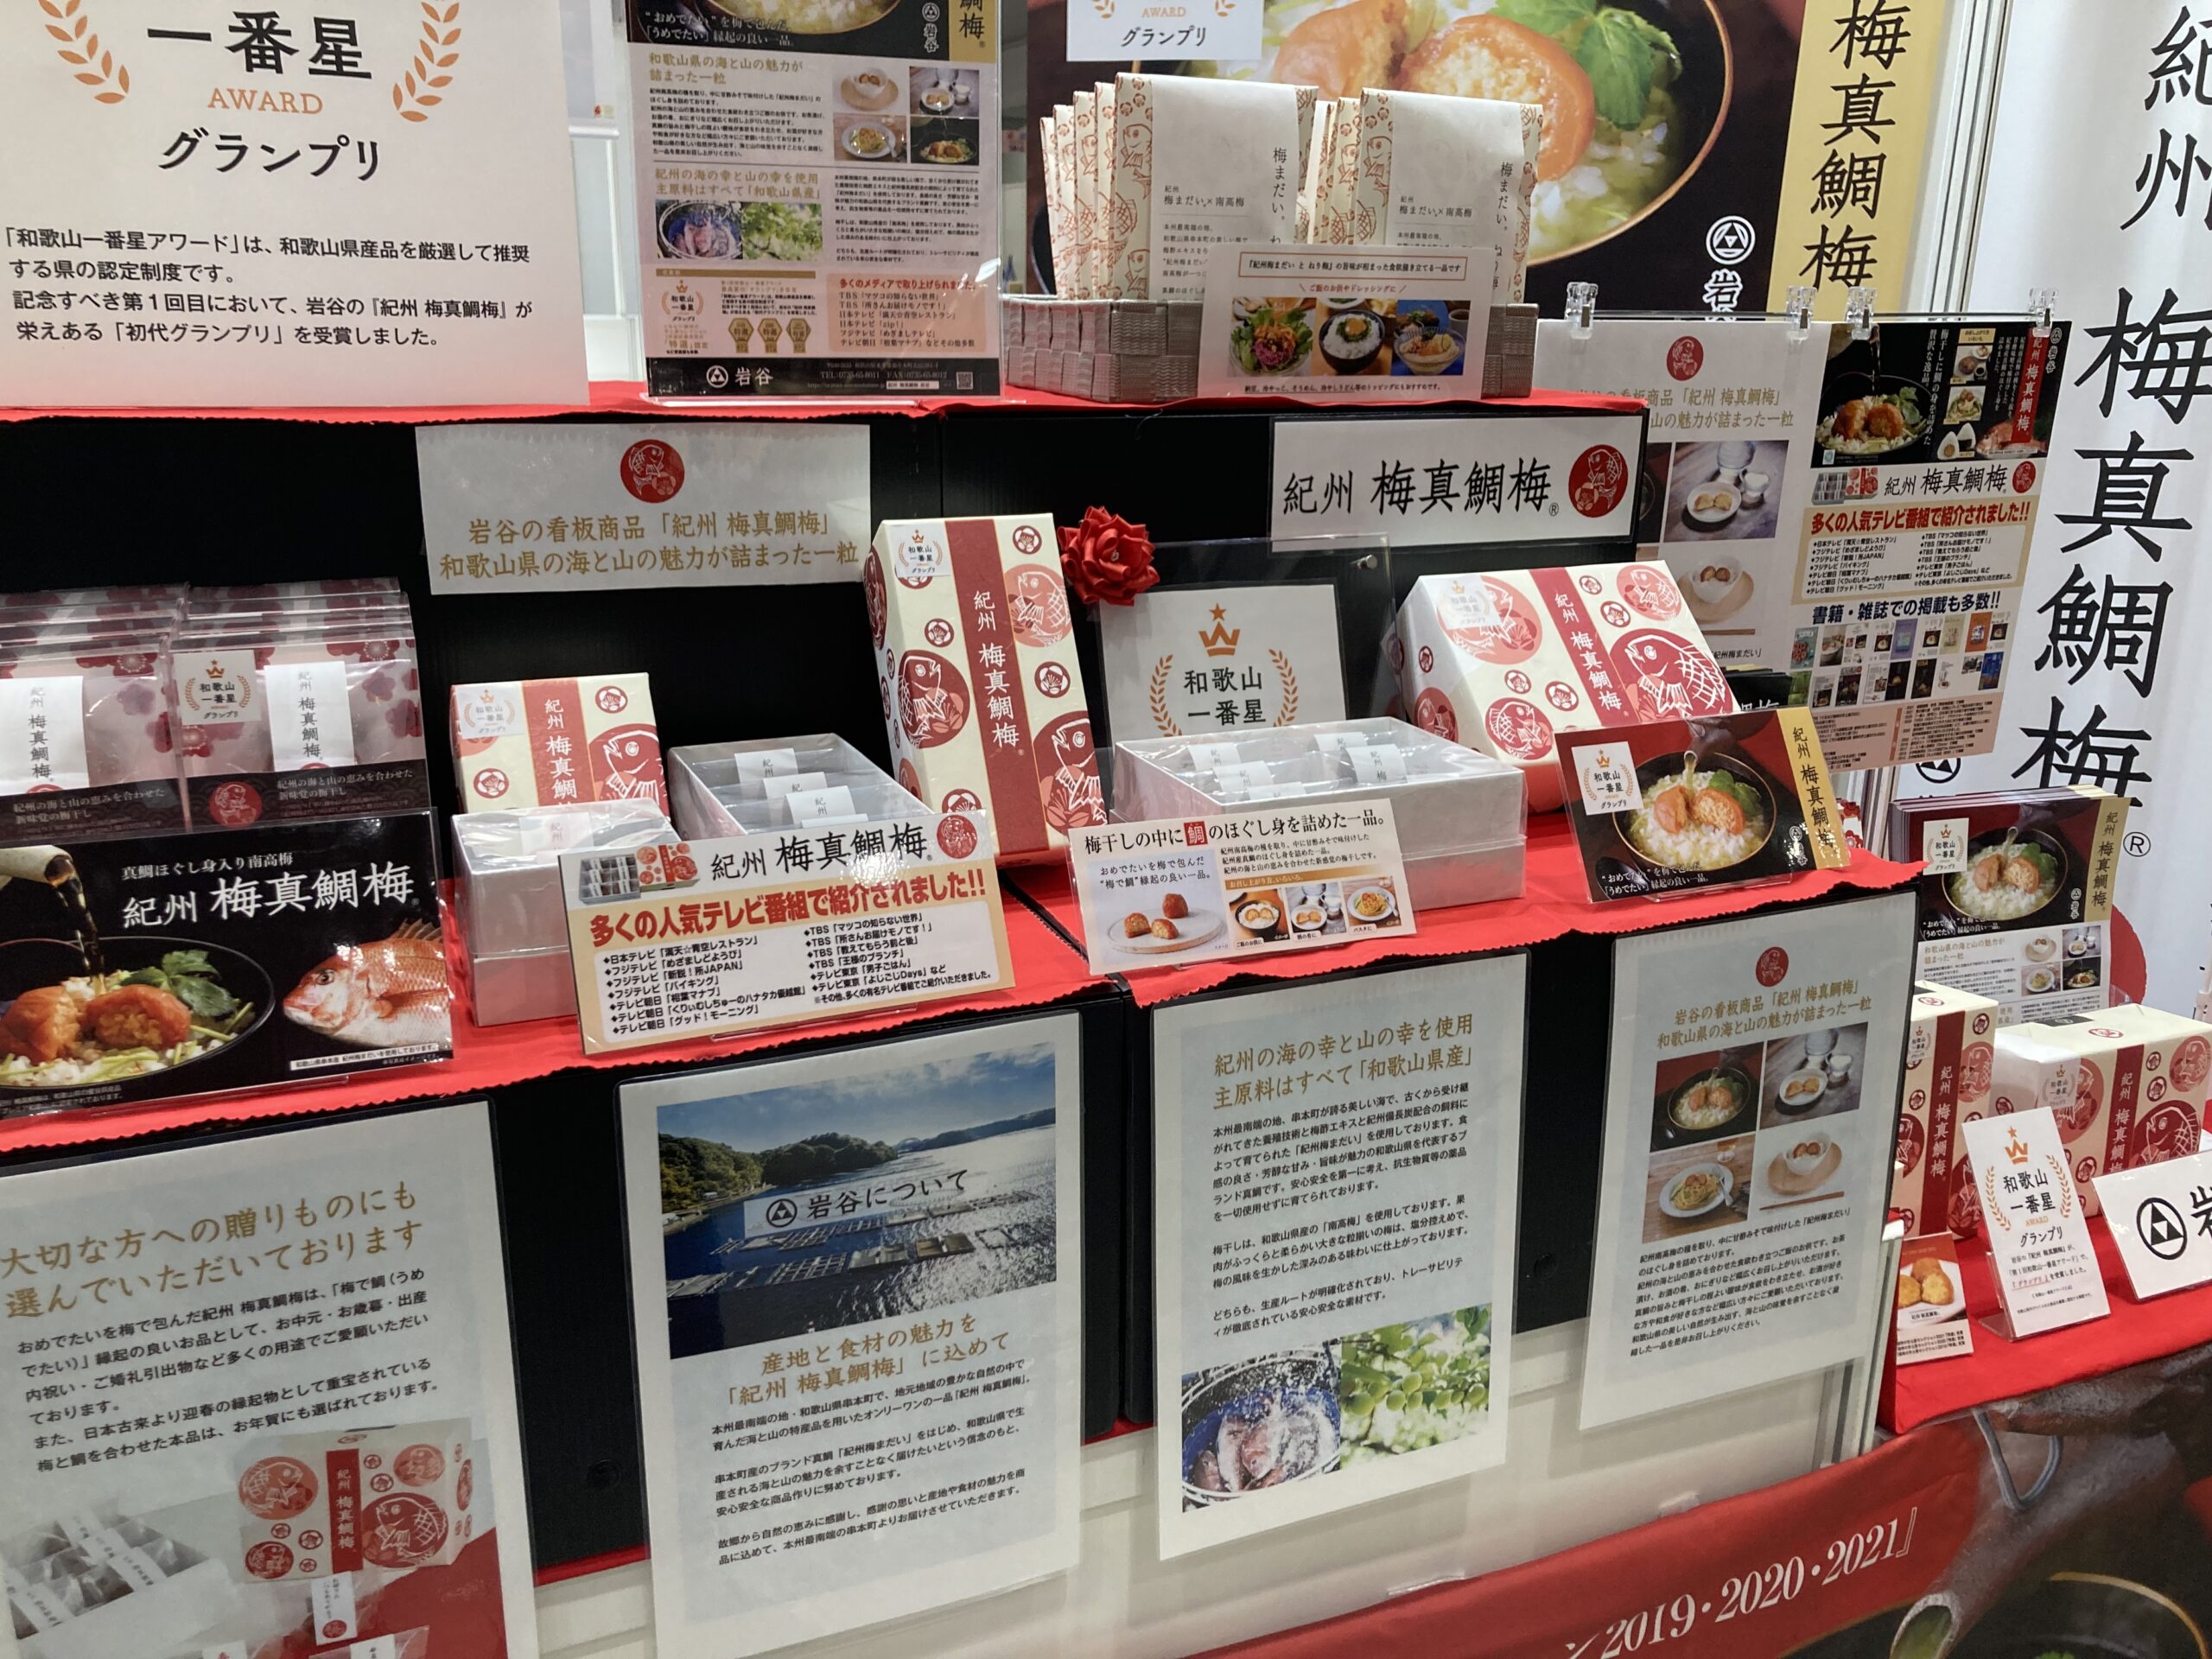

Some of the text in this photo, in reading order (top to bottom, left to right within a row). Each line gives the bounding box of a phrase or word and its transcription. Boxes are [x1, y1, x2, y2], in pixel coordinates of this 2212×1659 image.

[1141, 5, 1186, 18] AWARD
[148, 10, 372, 79] 一番星
[1121, 27, 1206, 48] グランプリ
[208, 88, 323, 115] AWARD
[158, 128, 380, 181] グランプリ
[1282, 471, 1354, 517] 紀州
[1884, 476, 1916, 497] 紀州
[1554, 594, 1580, 624] 紀州
[973, 590, 1020, 747] 紀州 梅真鯛梅
[1184, 665, 1263, 695] 和歌山
[1187, 698, 1267, 726] 一番星
[544, 698, 577, 804] 紀州 梅真鯛
[1793, 727, 1811, 759] 紀州
[711, 854, 767, 881] 紀州
[123, 860, 416, 930] 紀州 梅真鯛梅
[807, 1169, 969, 1219] 岩谷について
[2003, 1168, 2049, 1194] 和歌山
[2010, 1192, 2056, 1215] 一番星
[2019, 1225, 2063, 1248] グランプリ
[29, 1401, 122, 1427] ております。
